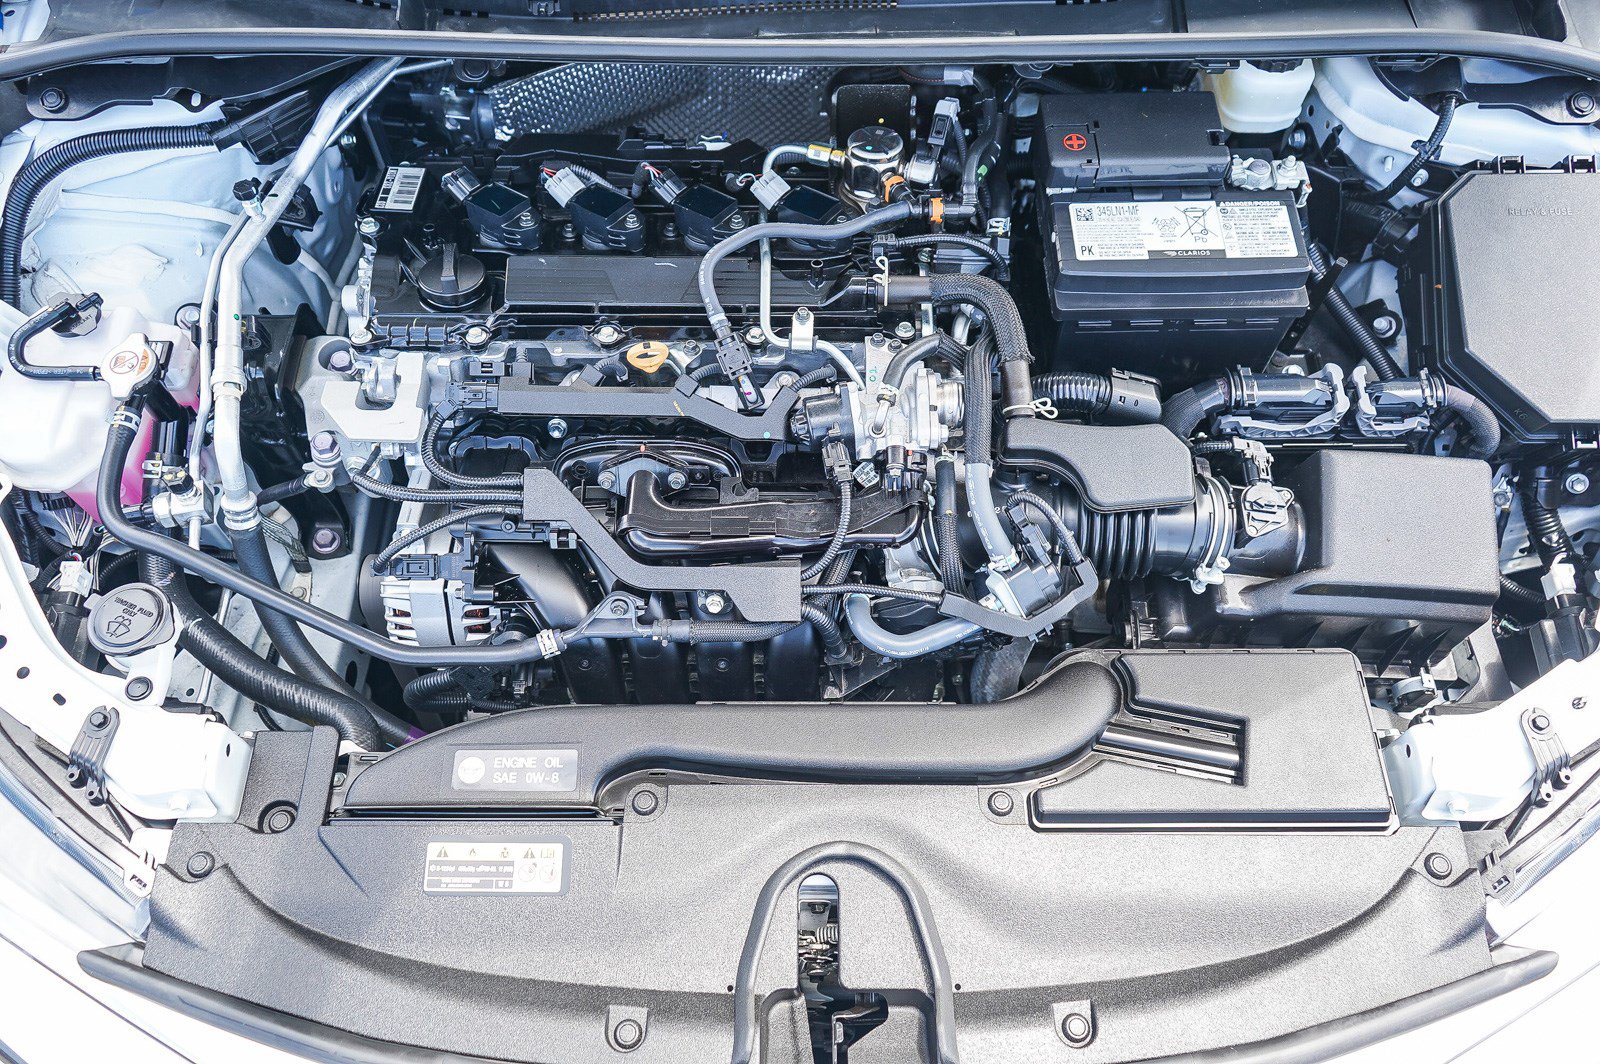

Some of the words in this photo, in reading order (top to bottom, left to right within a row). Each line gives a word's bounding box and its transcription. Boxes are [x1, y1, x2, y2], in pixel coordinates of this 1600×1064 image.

[1097, 205, 1140, 217] 345LN1-MF
[1507, 208, 1537, 216] RELAY
[1549, 208, 1573, 216] FUSE
[1081, 245, 1095, 256] PK
[493, 757, 537, 769] ENGINE
[544, 757, 564, 769] OIL
[492, 772, 517, 784] SAE
